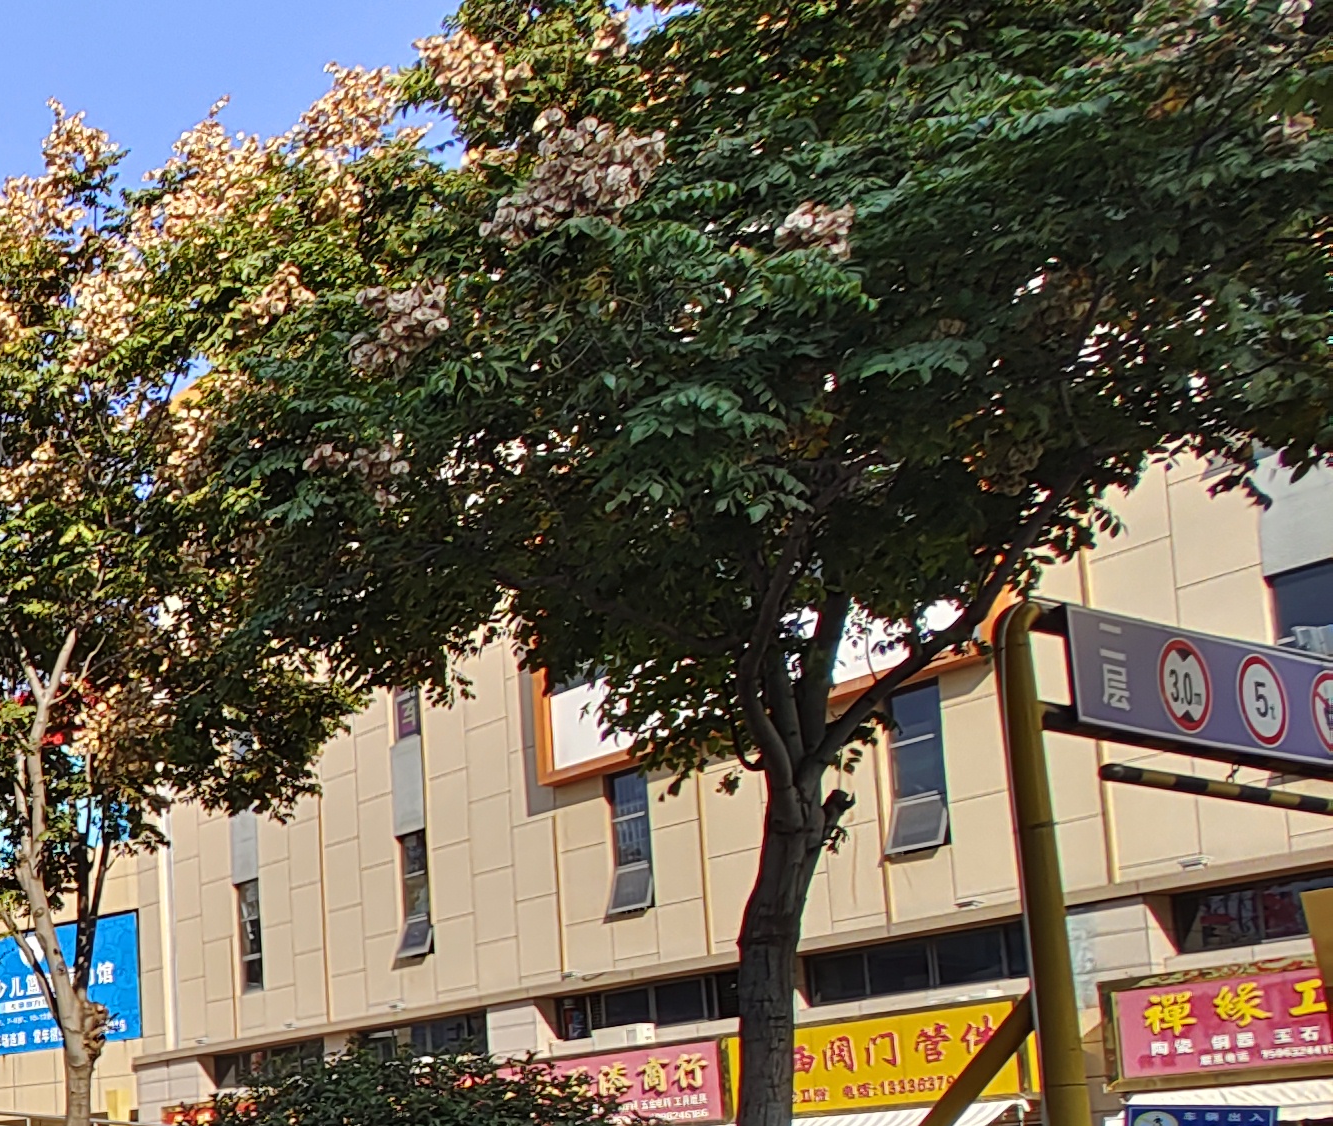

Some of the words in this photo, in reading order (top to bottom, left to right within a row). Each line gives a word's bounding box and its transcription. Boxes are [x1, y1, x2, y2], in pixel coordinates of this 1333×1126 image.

[1150, 1039, 1194, 1056] 陶瓷
[1274, 1026, 1320, 1044] 玉石
[1183, 1112, 1265, 1122] 车辆出入
